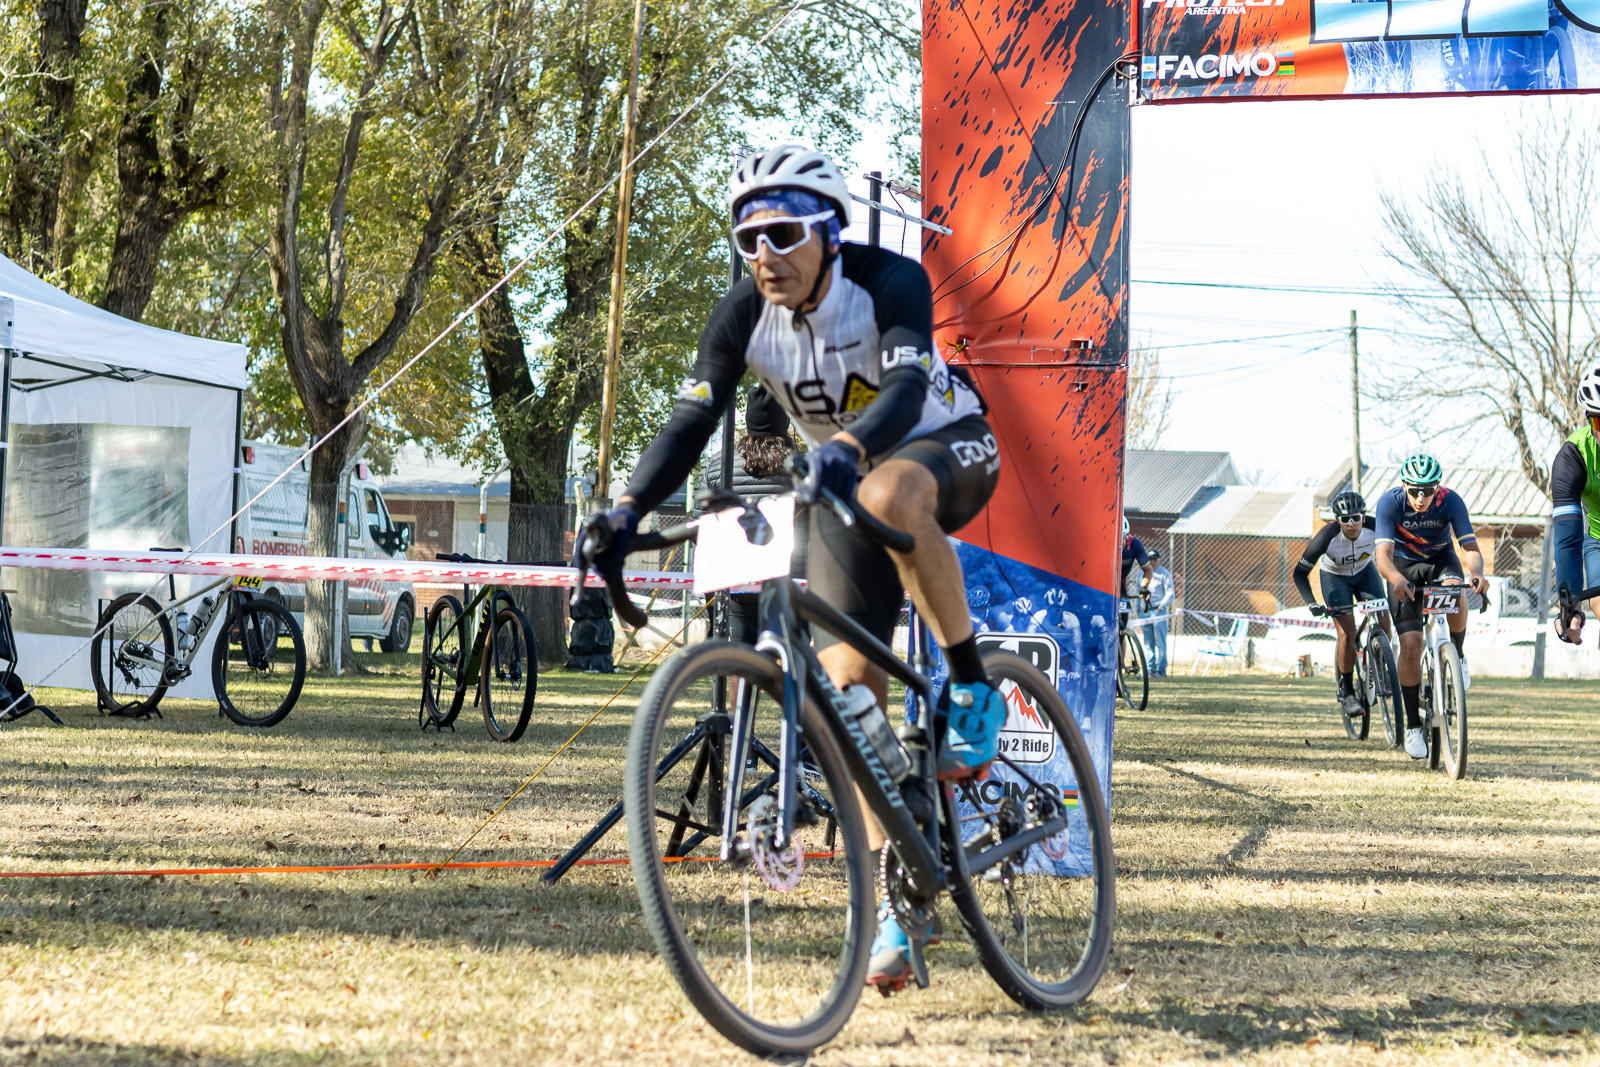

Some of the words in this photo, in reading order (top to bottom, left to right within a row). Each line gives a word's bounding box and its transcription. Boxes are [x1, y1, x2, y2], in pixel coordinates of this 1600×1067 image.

[1184, 6, 1246, 15] ARGENTINA
[1158, 53, 1276, 79] FACIMO
[252, 539, 309, 557] BOMBERO
[238, 576, 260, 587] 144
[1427, 594, 1457, 609] 174
[812, 667, 905, 809] SPECIALIZED
[1011, 738, 1020, 751] 2
[1022, 739, 1049, 752] Ride
[954, 780, 1060, 805] ACIMO
